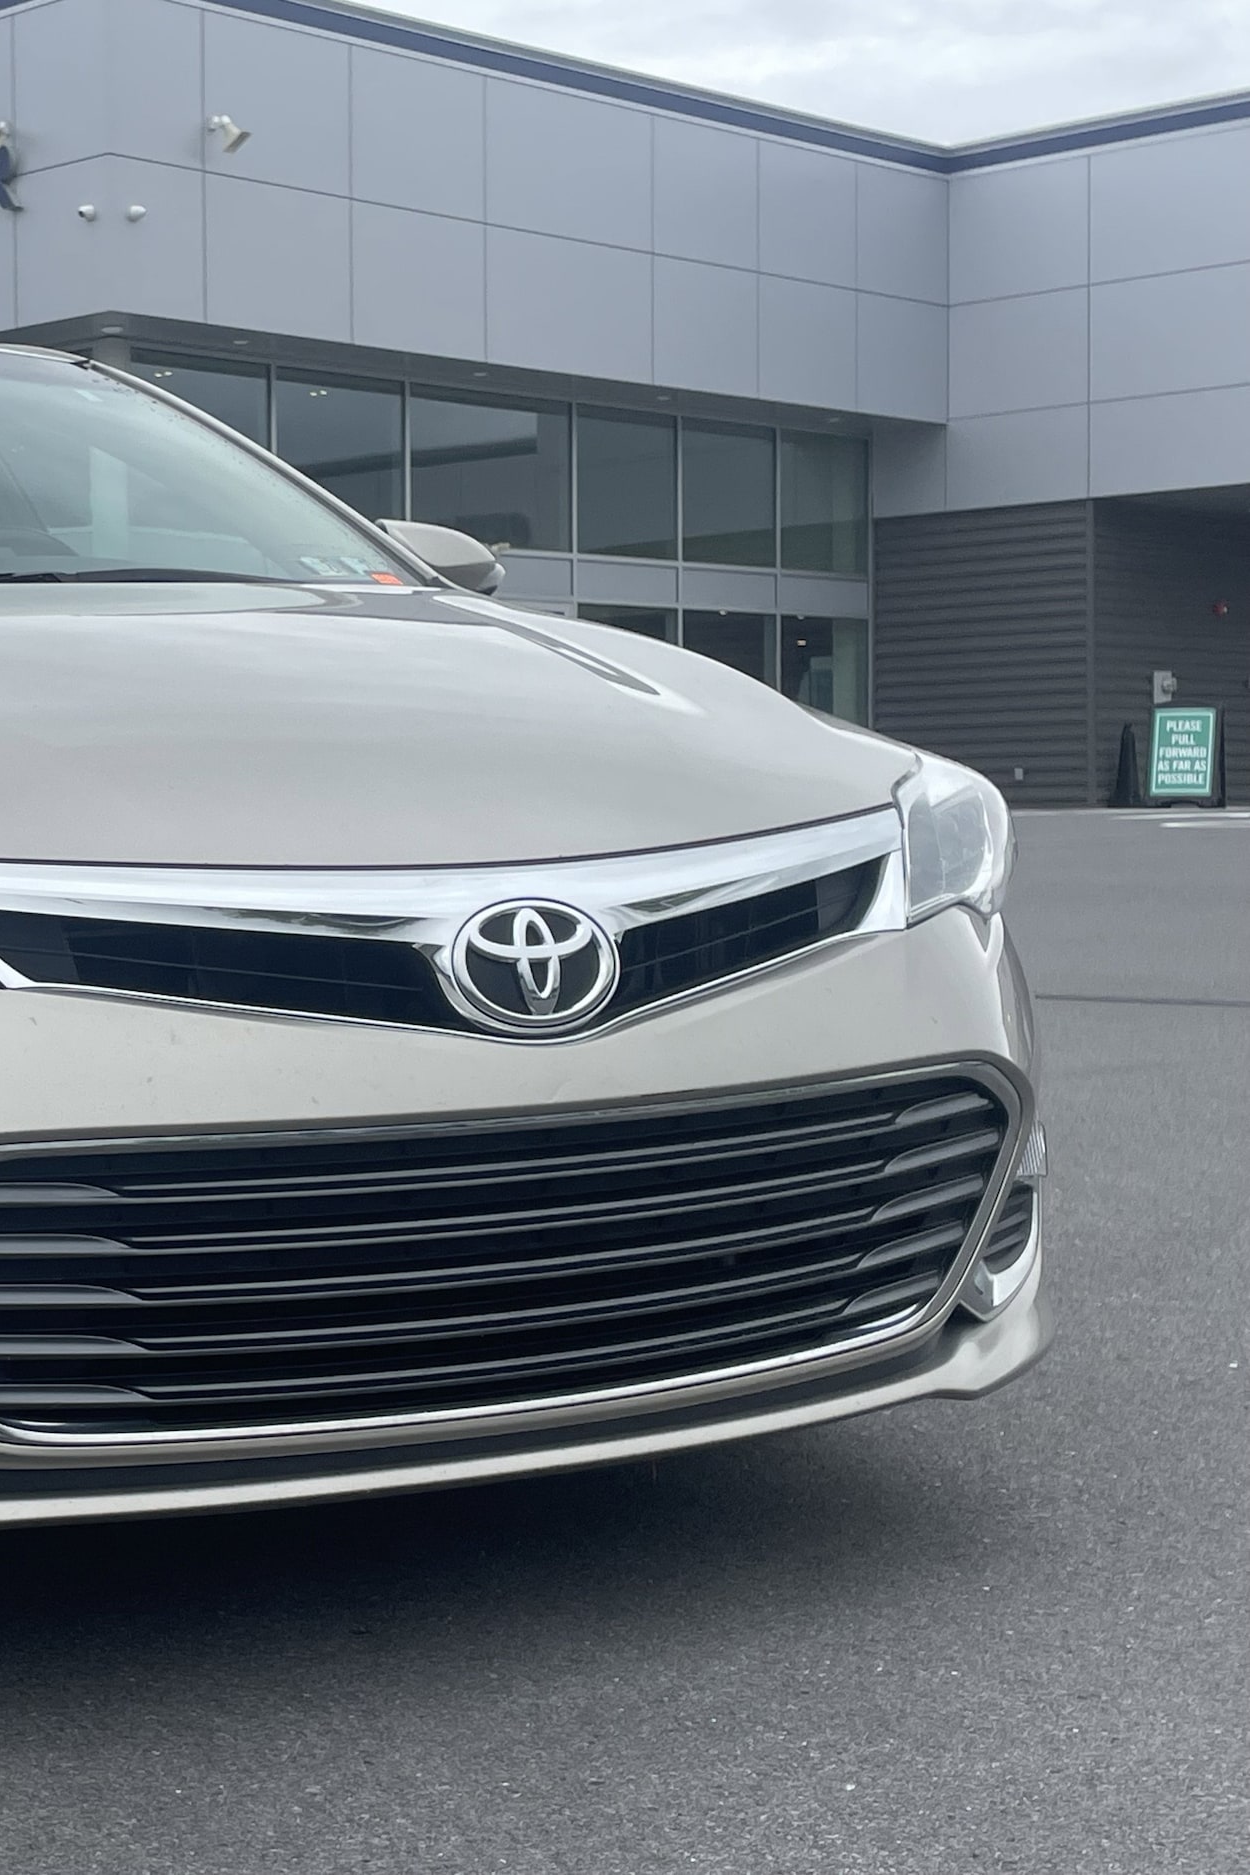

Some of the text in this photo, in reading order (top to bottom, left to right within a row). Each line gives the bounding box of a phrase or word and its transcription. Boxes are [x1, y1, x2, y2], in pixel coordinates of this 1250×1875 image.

[1166, 720, 1202, 732] PLEASE
[1171, 733, 1195, 745] PULL
[1159, 746, 1207, 758] FORWARD
[1158, 760, 1207, 771] AS FAR AS
[1157, 773, 1205, 784] POSSIBLE
